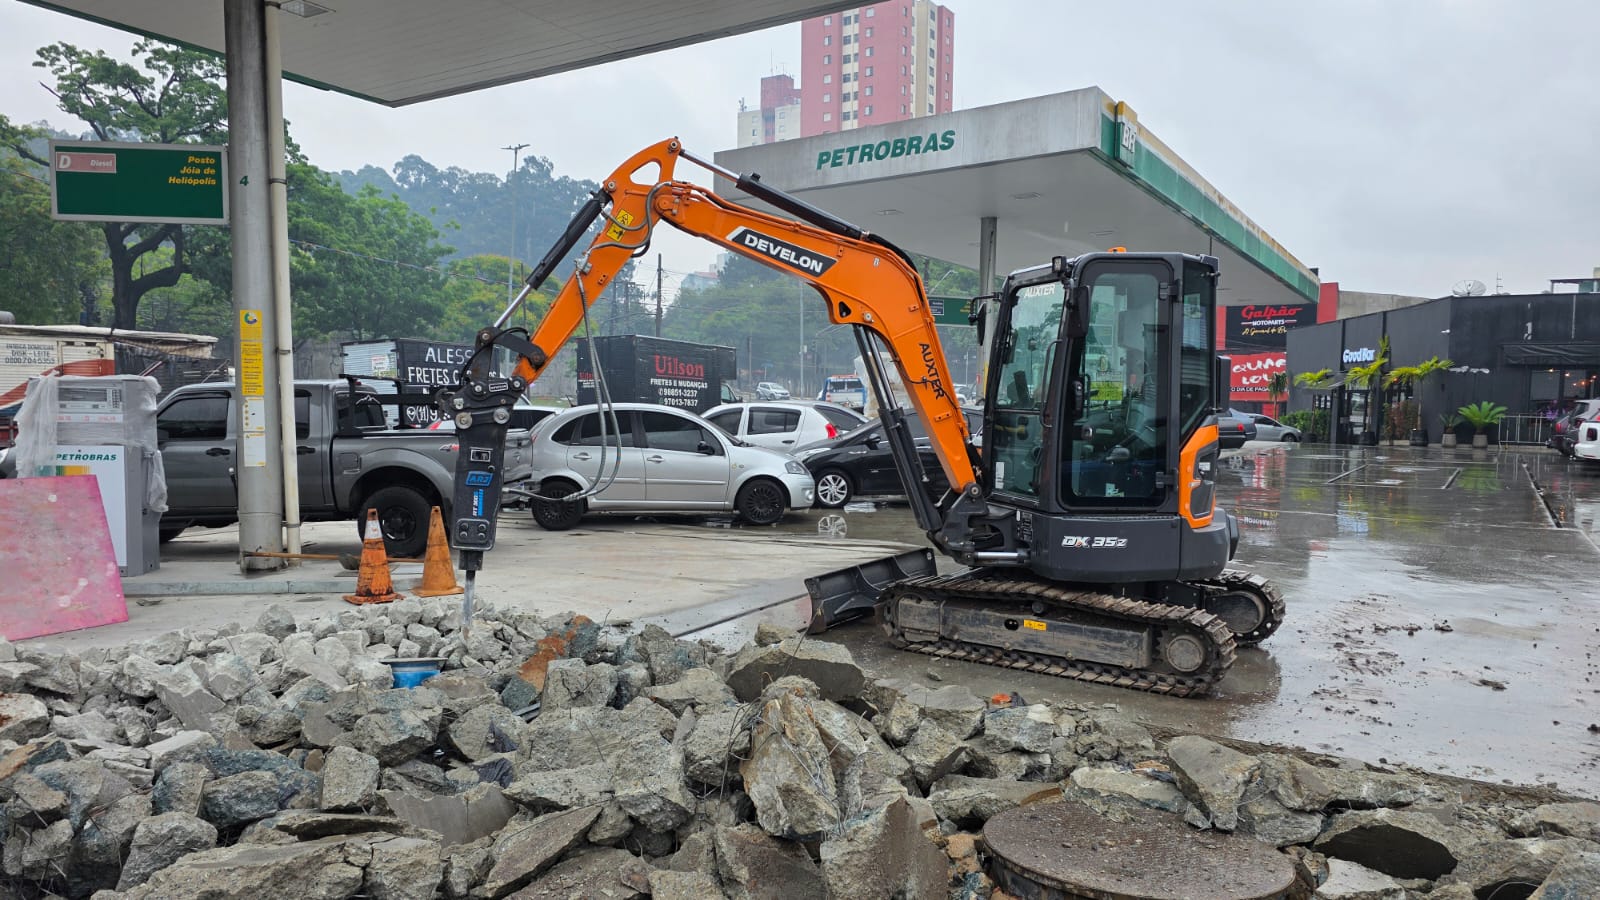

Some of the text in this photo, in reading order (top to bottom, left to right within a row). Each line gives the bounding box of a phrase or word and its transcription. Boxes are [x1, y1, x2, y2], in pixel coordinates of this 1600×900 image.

[816, 129, 956, 171] PETROBRAS
[58, 155, 113, 169] D Diesel
[188, 155, 216, 164] Posto
[180, 166, 216, 175] Jóia de
[168, 176, 216, 187] Heliópolis
[239, 175, 250, 187] 4
[744, 233, 823, 273] DEVELON
[1024, 284, 1056, 299] AUXTER
[1241, 305, 1302, 319] Galpão
[407, 366, 450, 385] FRETES
[919, 342, 945, 400] AUXTER
[650, 378, 672, 386] FRETES
[678, 380, 708, 390] MUDANÇAS
[56, 453, 117, 461] PETROBRAS
